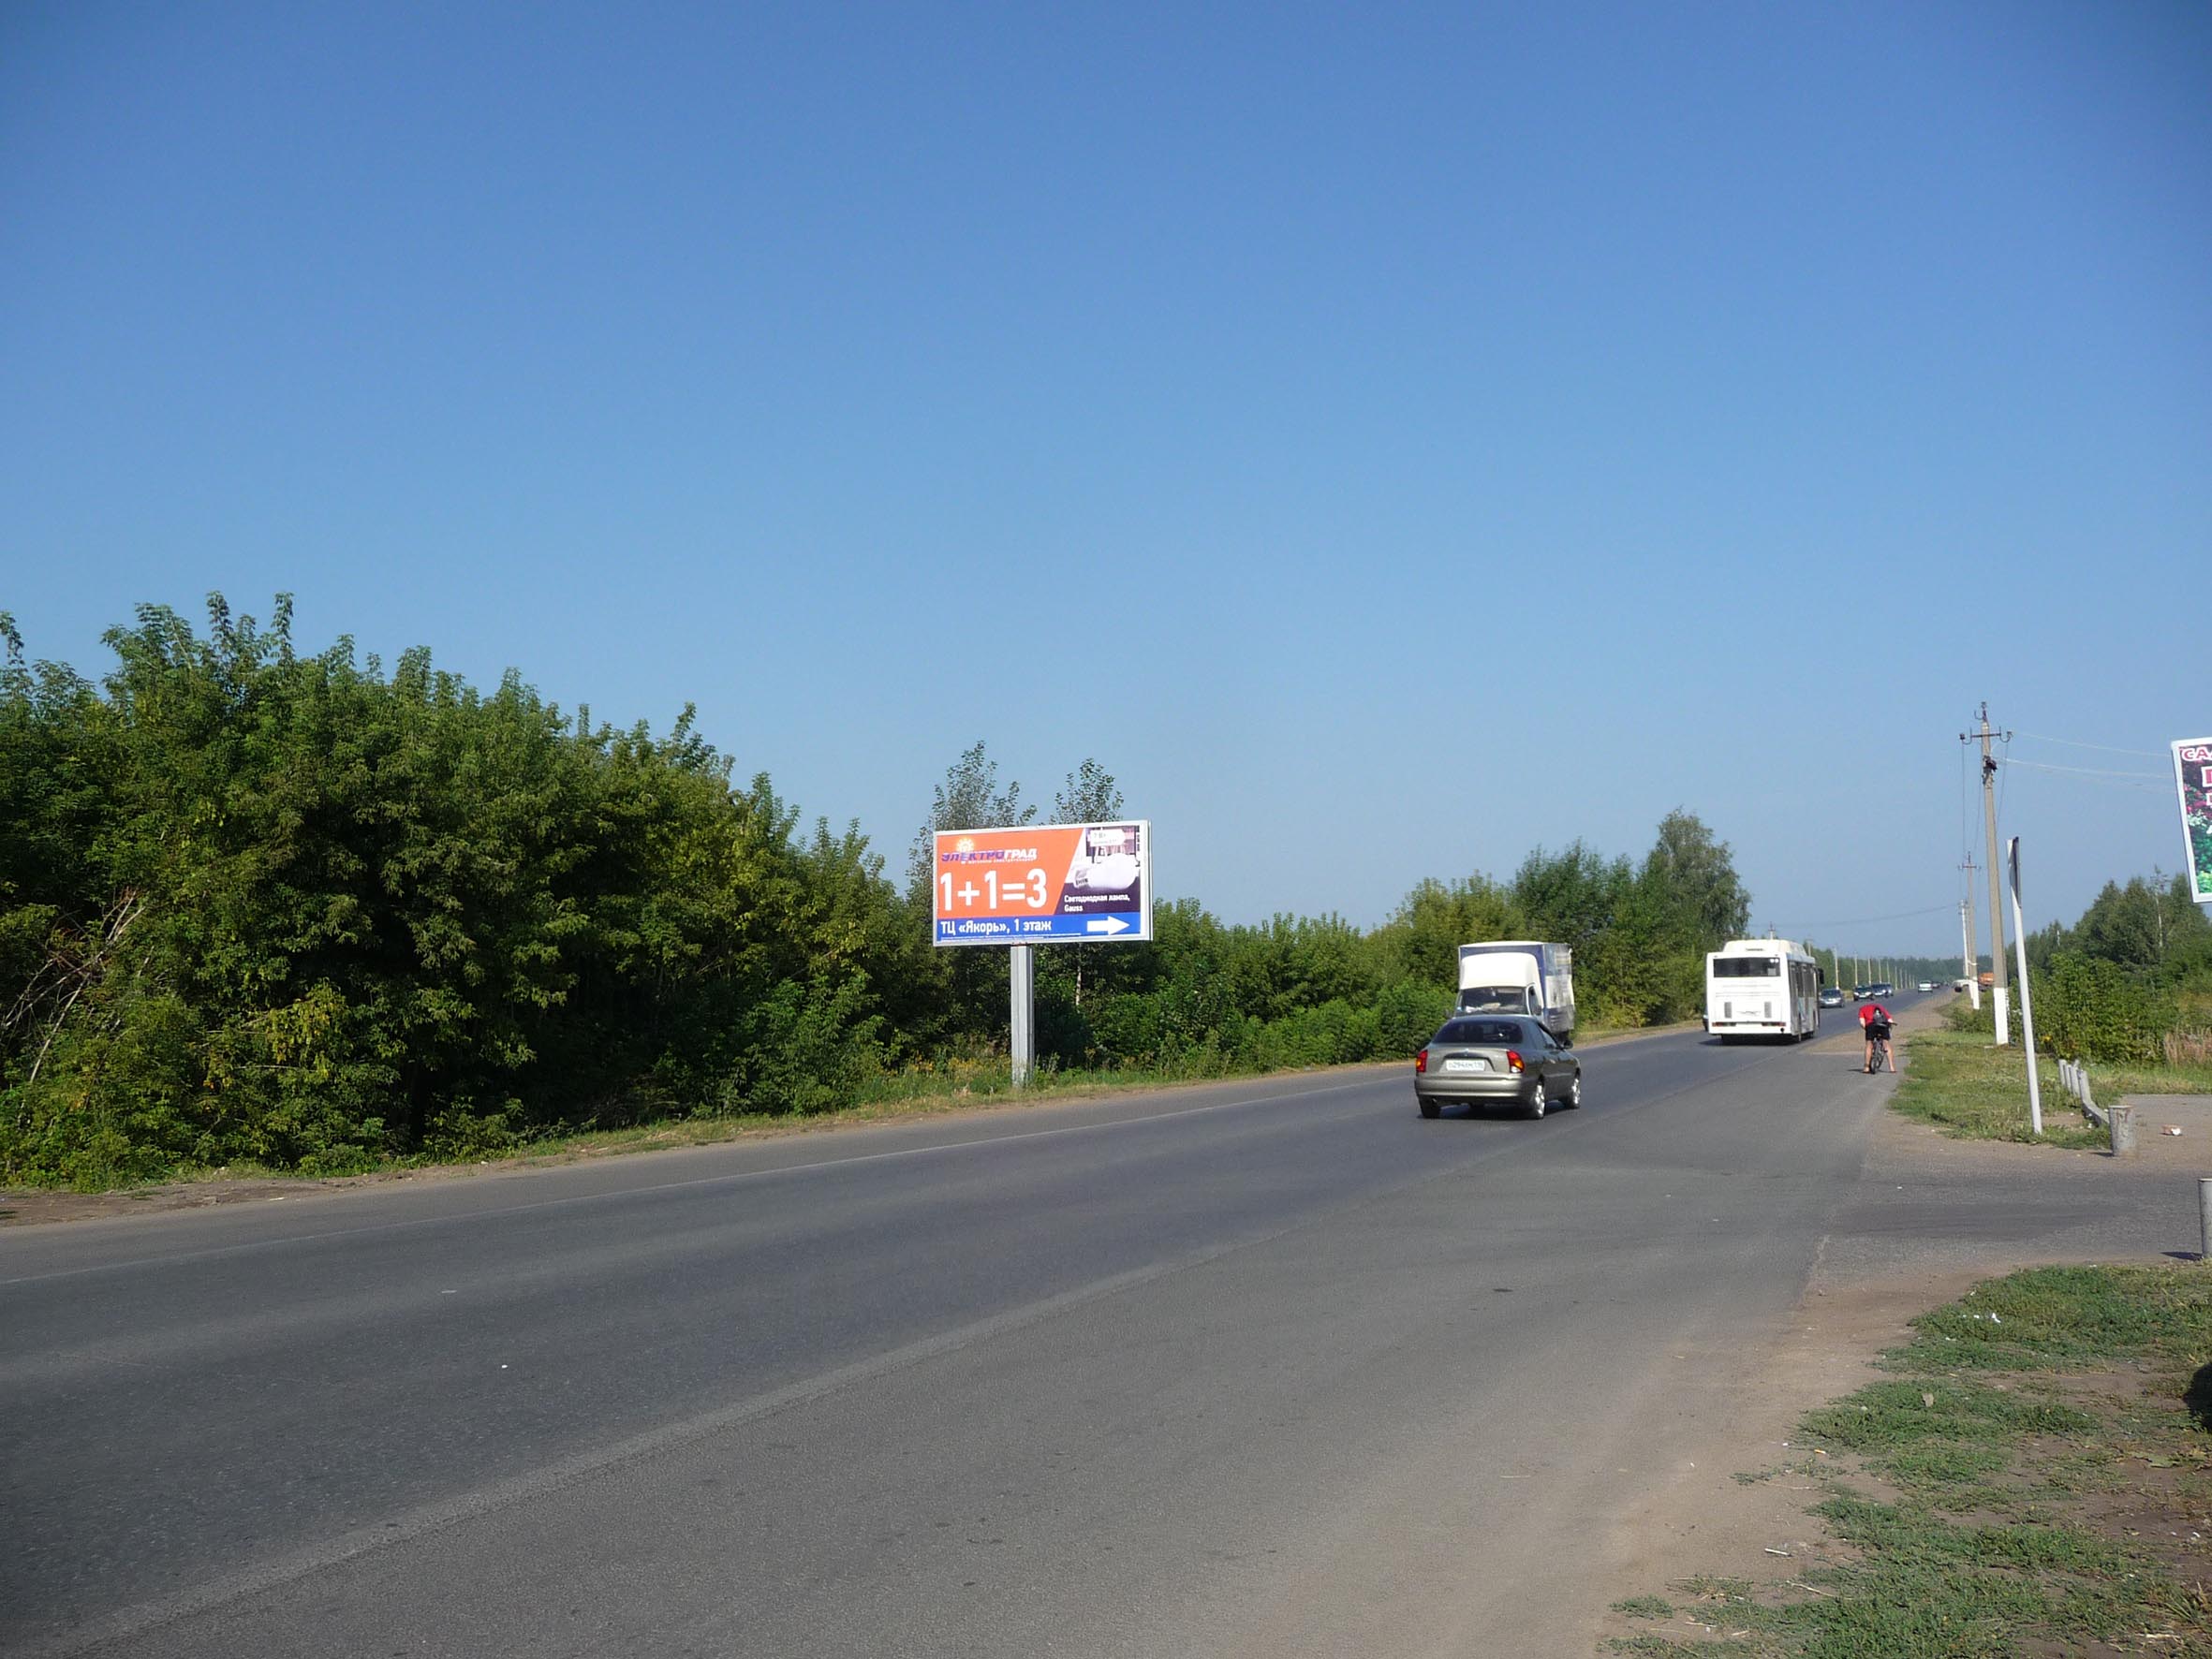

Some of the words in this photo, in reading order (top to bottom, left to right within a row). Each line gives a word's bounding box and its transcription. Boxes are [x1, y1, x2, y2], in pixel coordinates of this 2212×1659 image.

[941, 848, 1038, 861] ЭЛЕКТРОГРАД
[940, 868, 1047, 911] 1+1=3
[940, 921, 956, 935] ТЦ
[958, 919, 1010, 935] «Якорь»,
[1014, 918, 1020, 932] 1
[1023, 920, 1052, 932] этаж
